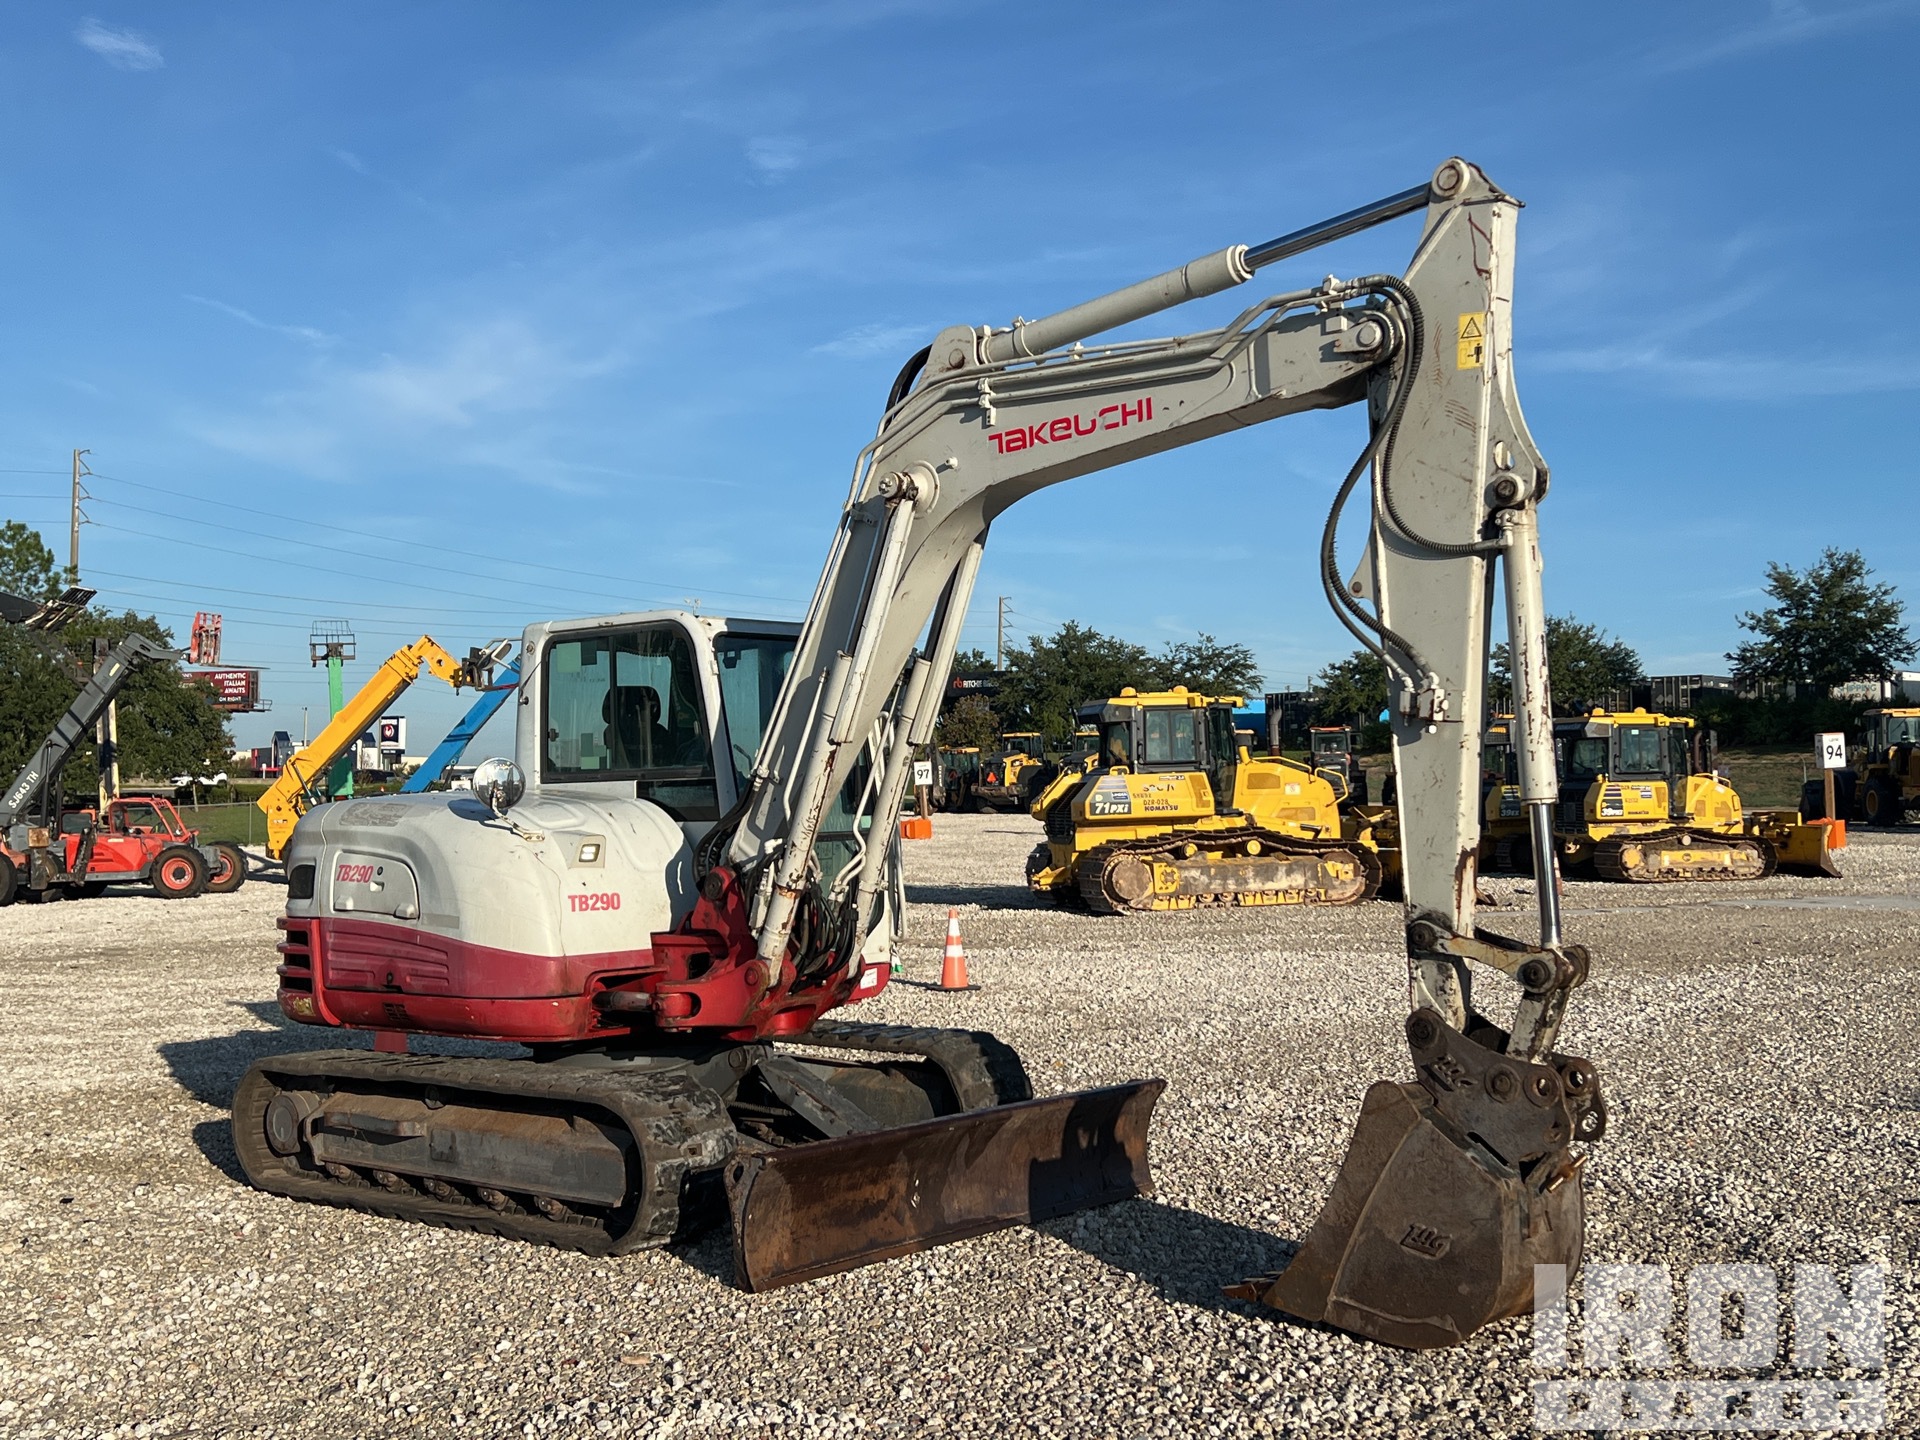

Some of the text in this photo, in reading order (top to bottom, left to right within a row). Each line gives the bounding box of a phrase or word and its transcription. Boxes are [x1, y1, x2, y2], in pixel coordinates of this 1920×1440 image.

[988, 397, 1153, 454] TAKEUCHI
[214, 672, 247, 680] AUTHENTIC
[1826, 744, 1843, 760] 94
[916, 768, 930, 780] 97
[8, 770, 39, 809] SJ643 TH
[1144, 804, 1179, 812] KOMATSU
[336, 864, 374, 883] TB290
[567, 892, 621, 912] TB290
